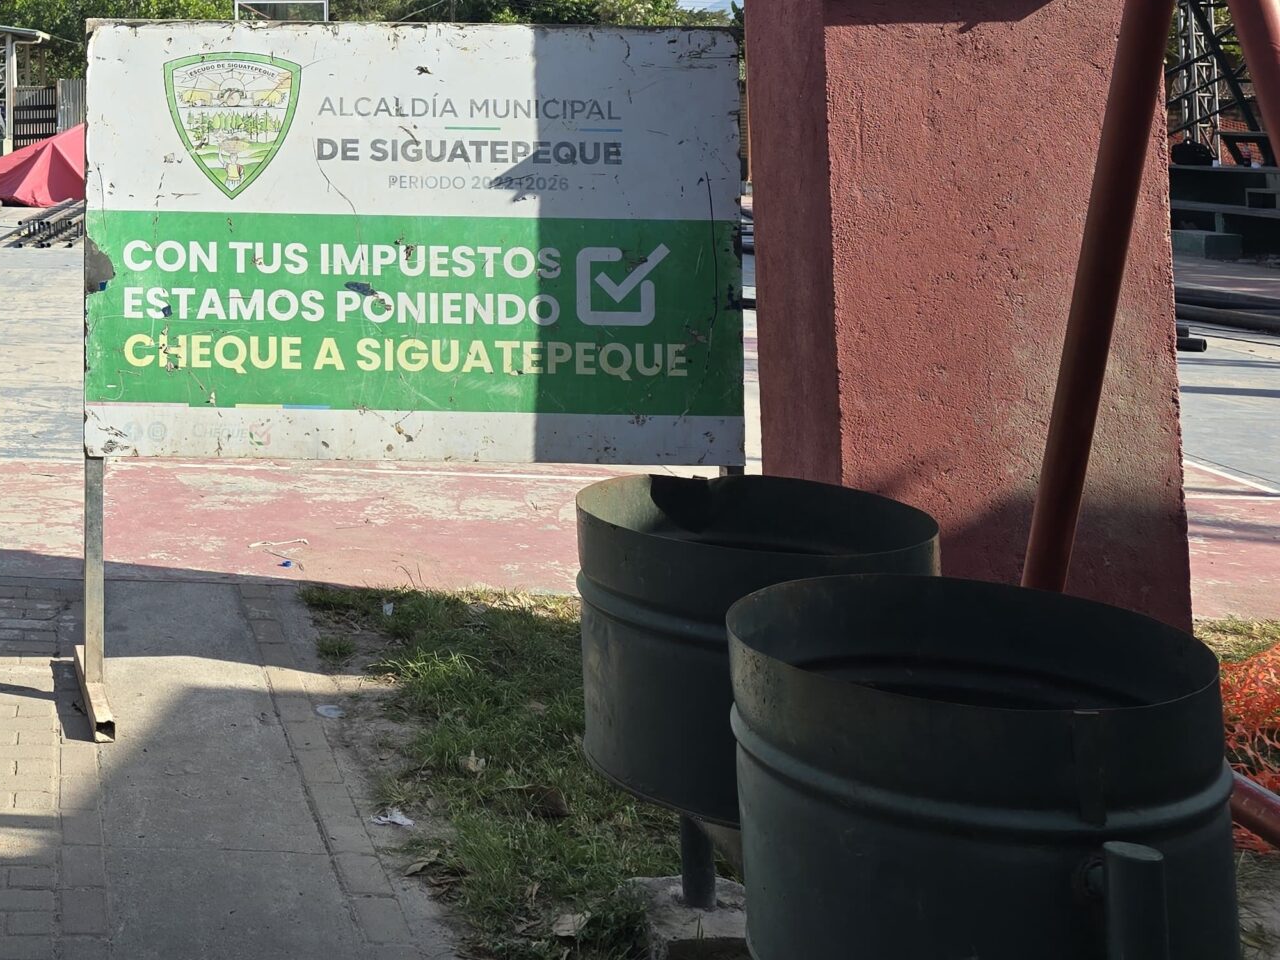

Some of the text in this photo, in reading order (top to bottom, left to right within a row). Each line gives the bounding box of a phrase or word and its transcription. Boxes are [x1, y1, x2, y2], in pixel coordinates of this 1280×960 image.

[189, 65, 215, 77] ESCUDO
[227, 63, 275, 78] SIGUATEPEQUE
[317, 93, 622, 121] ALCALDÍA MUNICIPAL
[316, 138, 623, 166] DE SIGUATEPEQUE
[388, 175, 570, 191] PERIODO 2022-2026
[122, 240, 562, 279] CON TUS IMPUESTOS
[123, 287, 561, 326] ESTAMOS PONIENDO
[123, 333, 689, 382] CHEQUE A SIGUATEPEQUE
